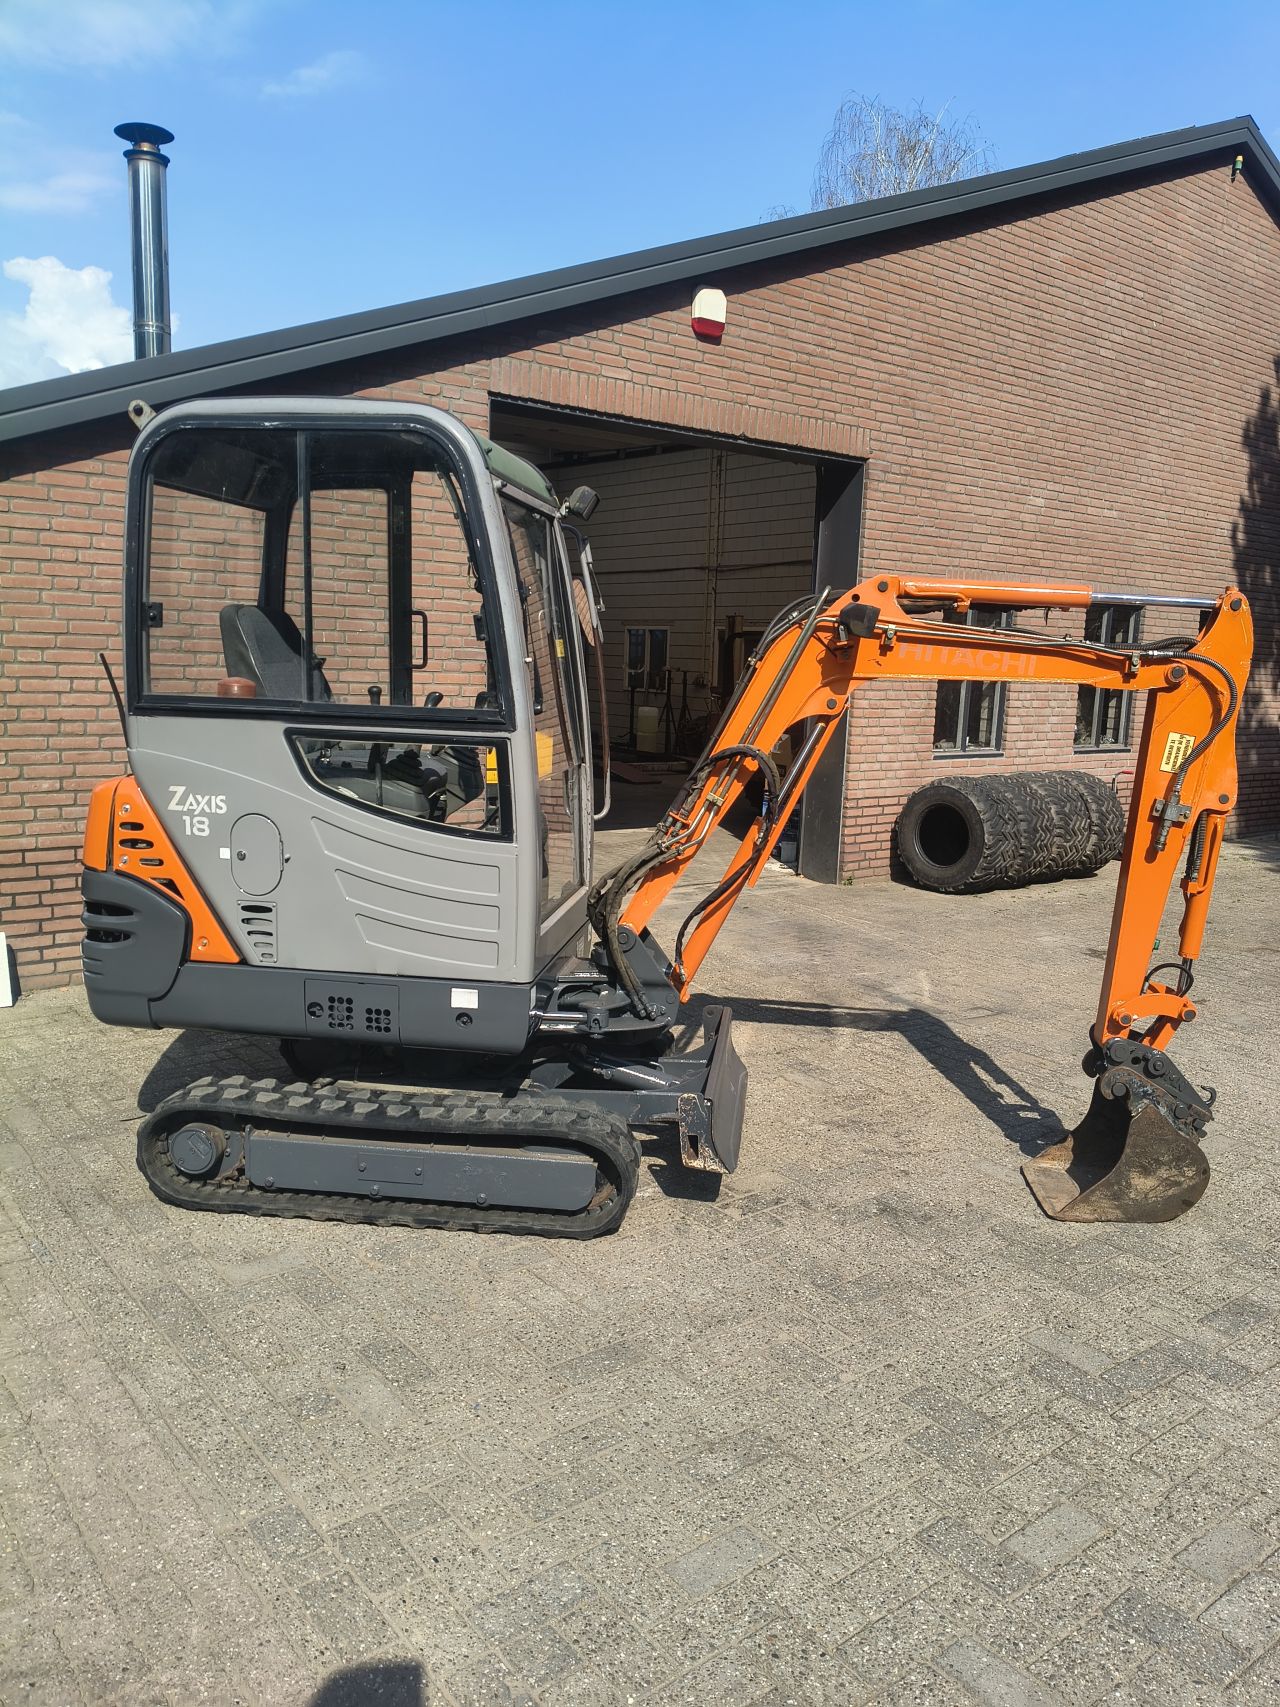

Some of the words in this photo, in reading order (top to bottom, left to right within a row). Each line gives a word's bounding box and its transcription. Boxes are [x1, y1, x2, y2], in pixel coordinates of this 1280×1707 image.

[898, 641, 1038, 676] HITACHI
[167, 785, 227, 815] ZAXIS
[182, 815, 210, 837] 18
